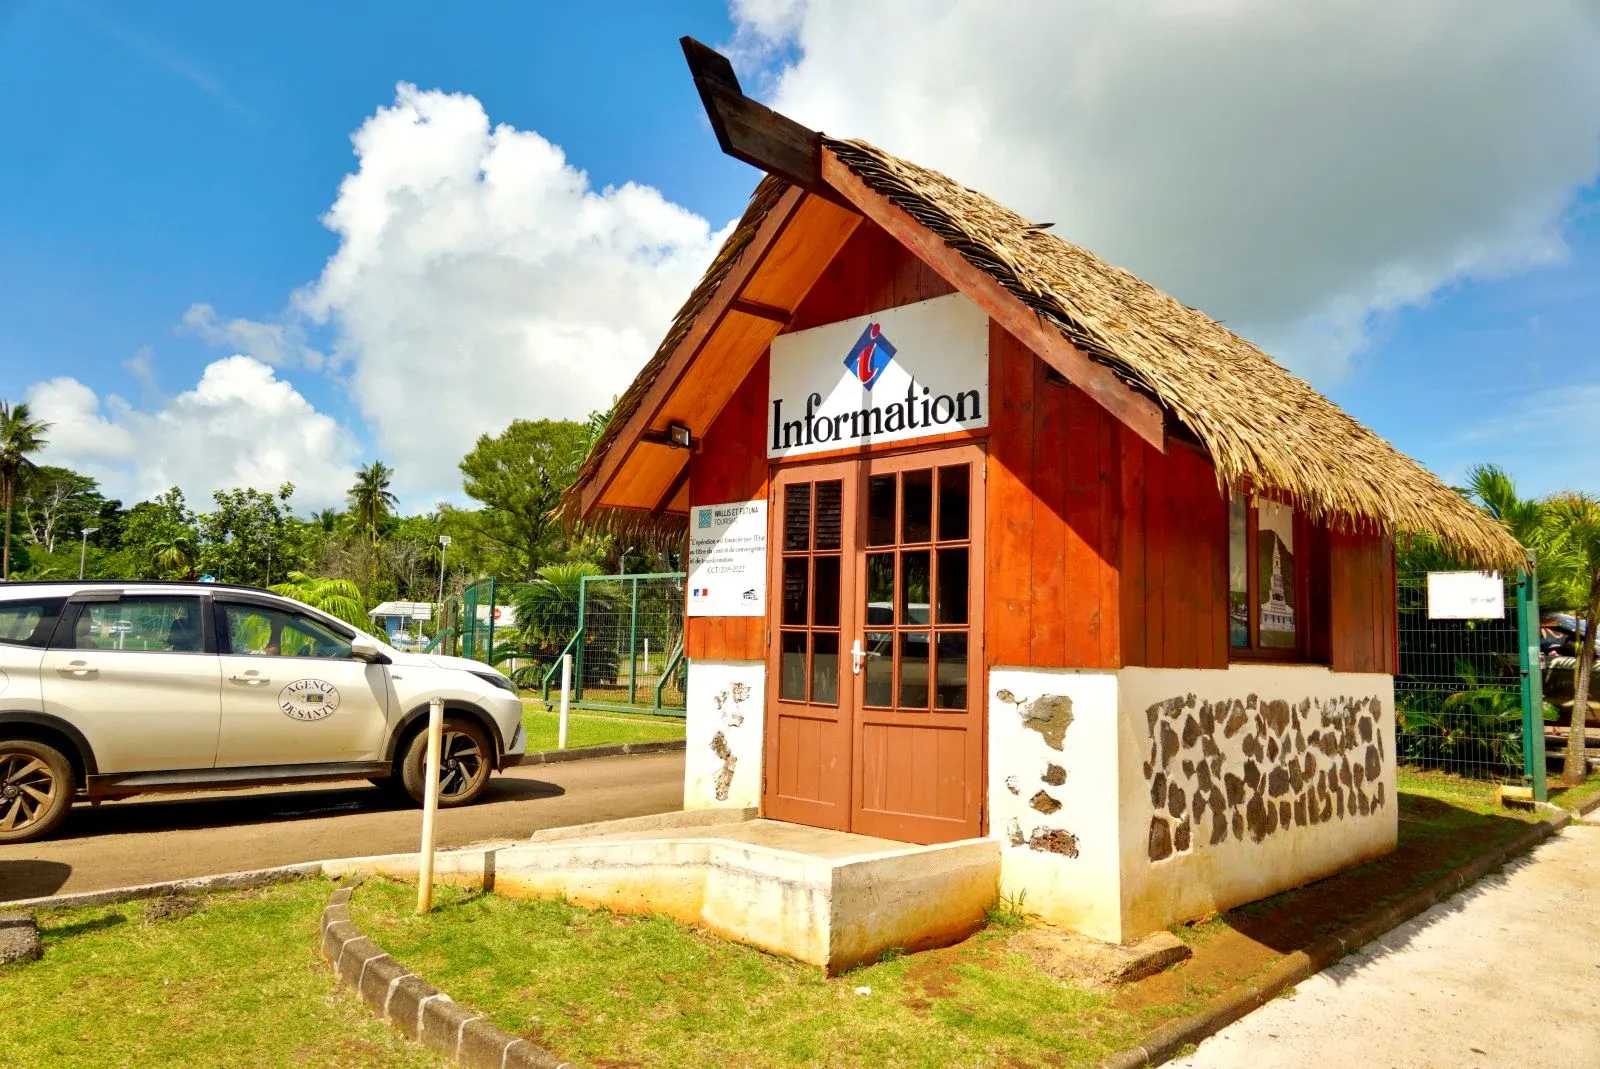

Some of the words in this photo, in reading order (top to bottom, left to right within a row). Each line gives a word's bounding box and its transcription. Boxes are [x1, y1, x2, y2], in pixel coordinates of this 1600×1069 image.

[772, 374, 982, 450] Information
[714, 509, 731, 517] WALLIS
[731, 508, 738, 516] ET
[287, 681, 336, 696] AGENCE
[282, 702, 296, 715] DE
